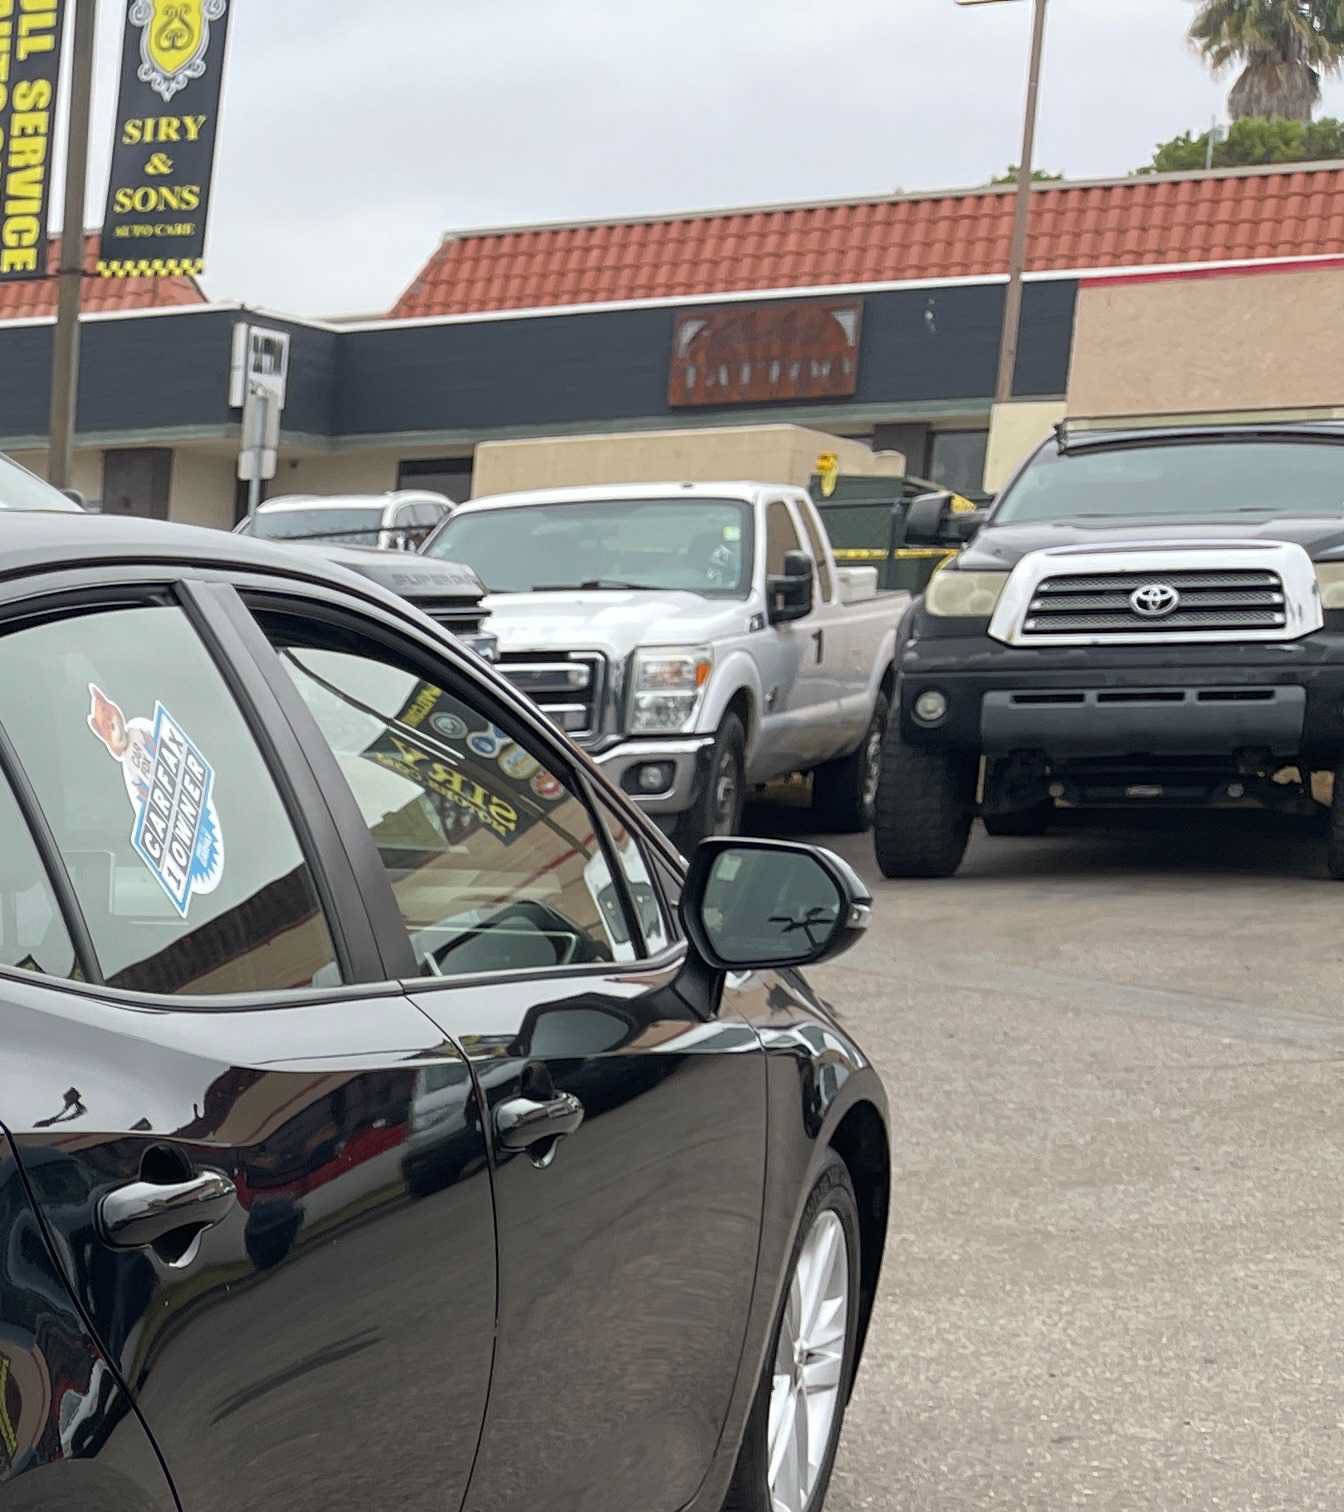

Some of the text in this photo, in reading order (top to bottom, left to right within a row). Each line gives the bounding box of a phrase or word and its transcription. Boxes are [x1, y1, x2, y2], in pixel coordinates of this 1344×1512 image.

[122, 115, 207, 145] SIRY
[143, 152, 173, 175] &
[0, 79, 53, 273] SERVICE
[113, 185, 200, 214] SONS
[143, 728, 184, 859] CARFAX
[171, 753, 207, 868] OWNER
